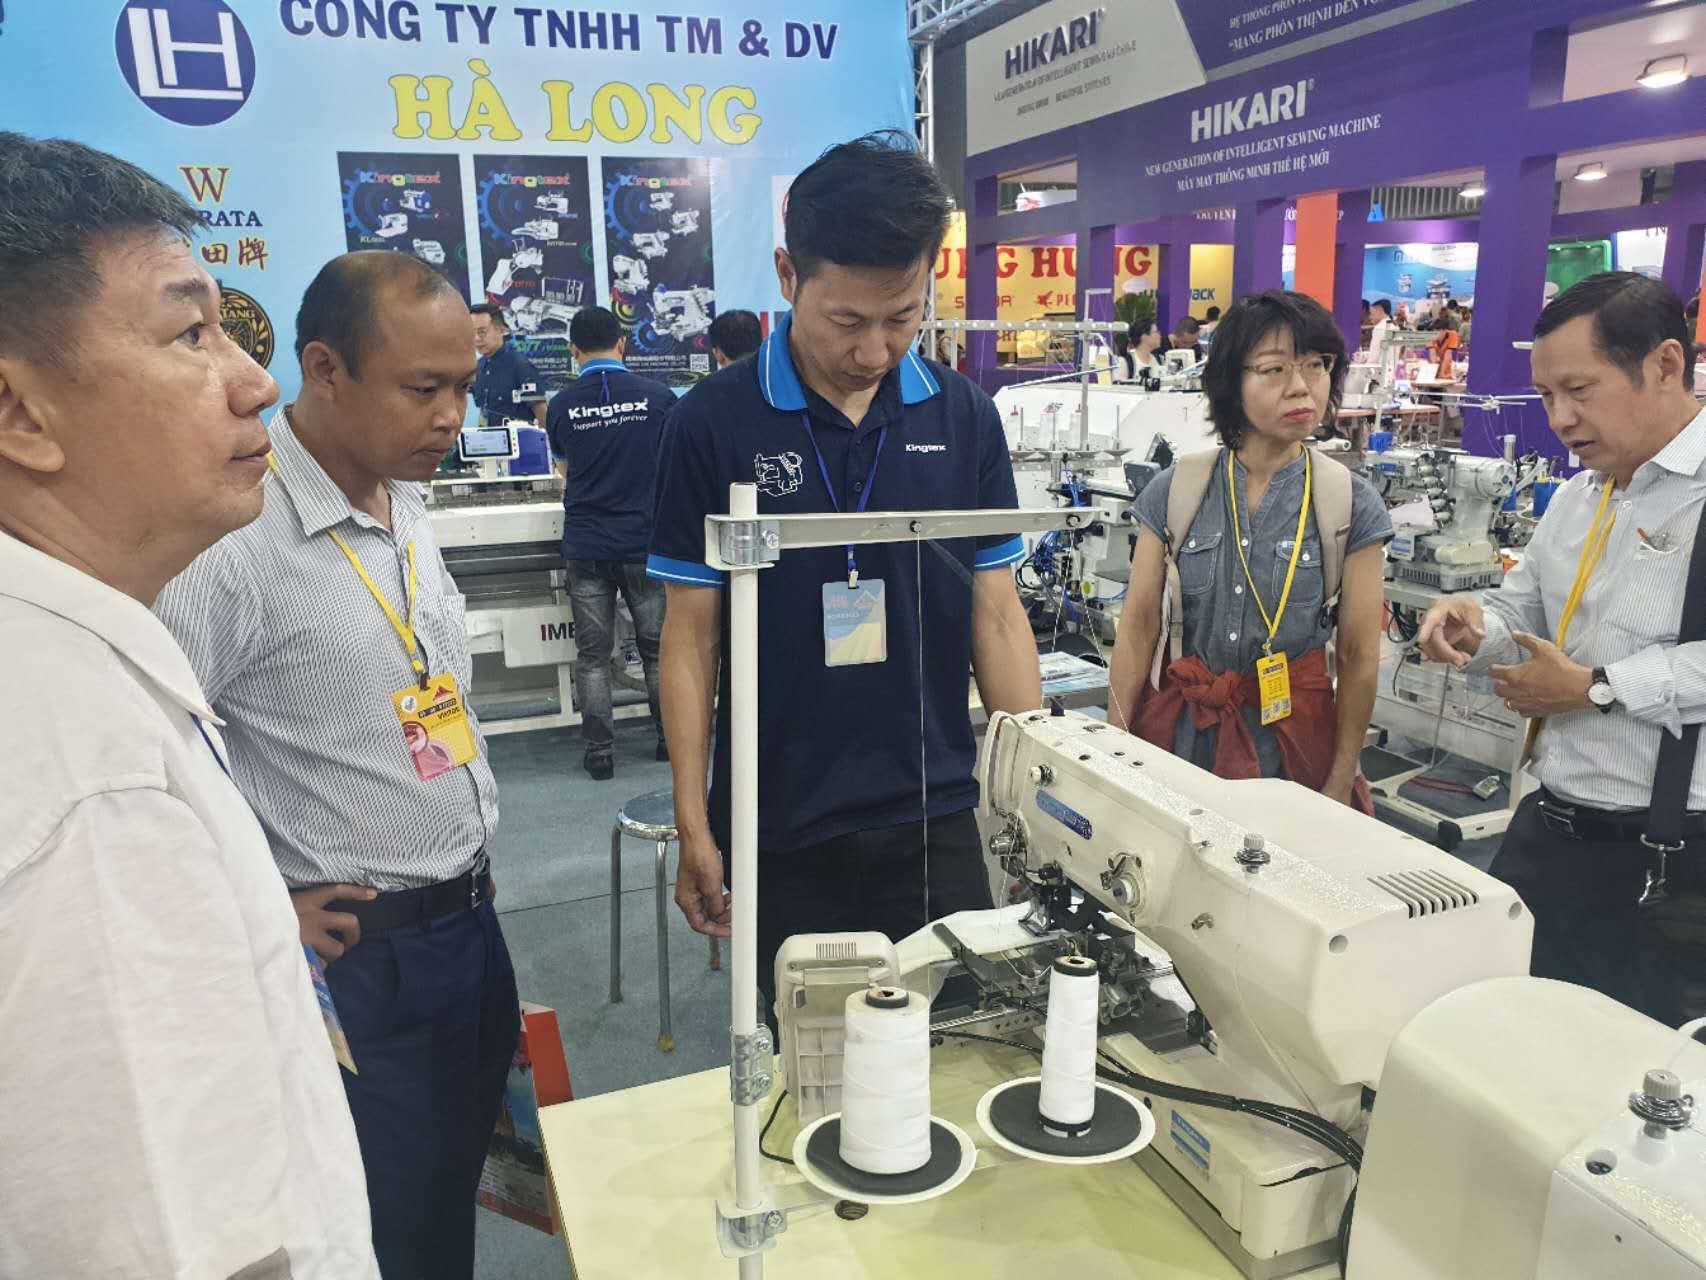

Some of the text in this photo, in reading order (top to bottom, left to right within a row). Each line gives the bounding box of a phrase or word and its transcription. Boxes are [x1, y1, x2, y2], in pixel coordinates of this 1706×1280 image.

[435, 3, 497, 44] TY
[513, 8, 641, 51] TNHH
[656, 15, 723, 54] TM
[738, 19, 770, 58] &
[784, 22, 838, 59] DV
[1005, 10, 1099, 80] HIKARI
[388, 57, 762, 145] HÀ LONG
[1191, 79, 1308, 143] HIKARI
[1226, 135, 1286, 161] INTELLIGENT
[1286, 126, 1328, 148] SEWING
[1328, 113, 1383, 138] MACHINE
[198, 210, 263, 227] RATA
[568, 398, 648, 420] Kingtex
